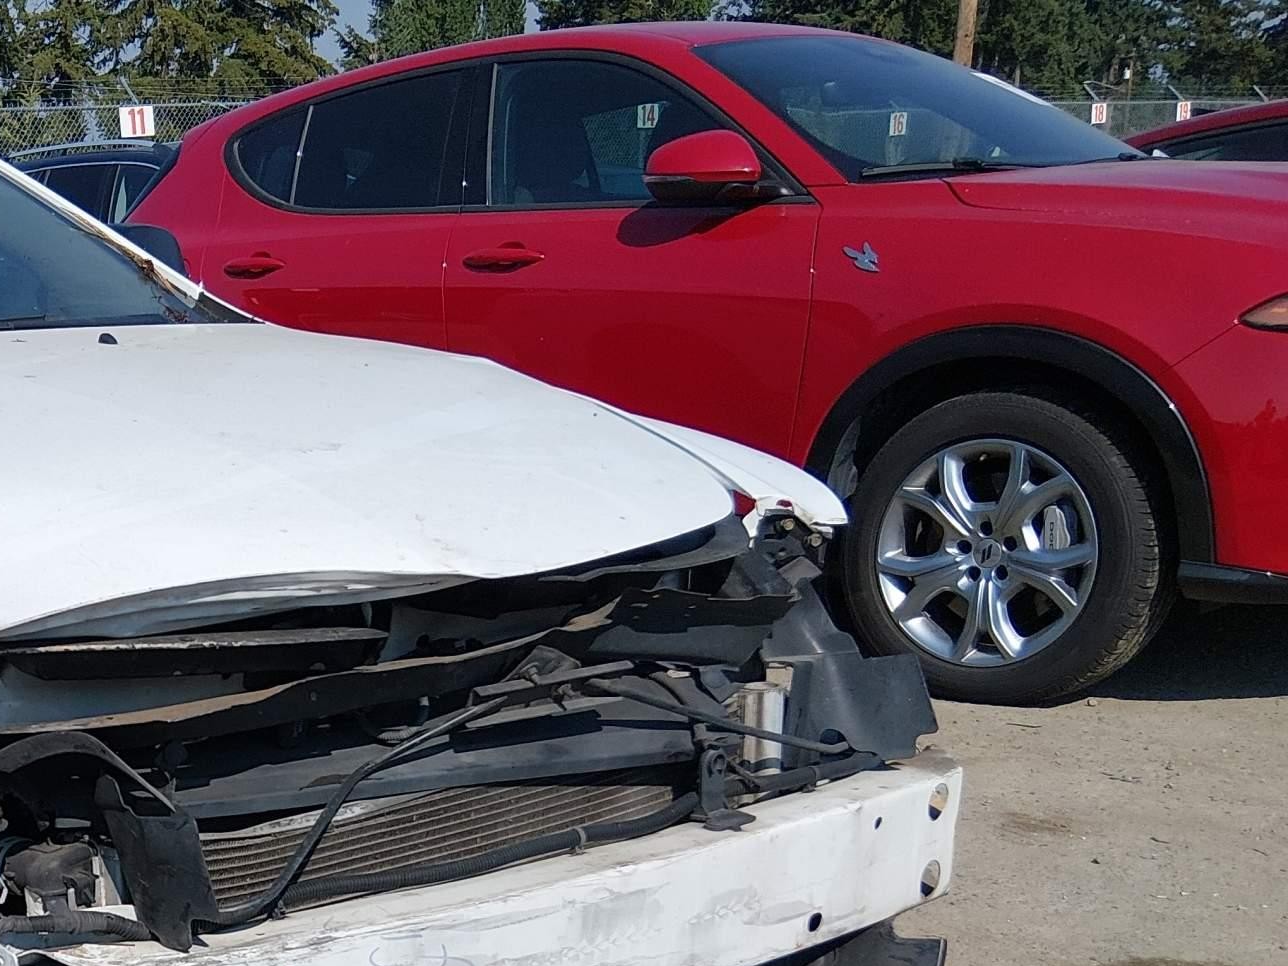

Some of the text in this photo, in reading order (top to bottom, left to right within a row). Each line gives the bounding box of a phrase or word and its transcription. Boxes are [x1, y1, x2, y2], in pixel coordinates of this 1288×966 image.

[128, 107, 146, 135] 11
[641, 104, 656, 127] 14
[1094, 104, 1104, 122] 18
[1179, 102, 1189, 120] 19
[893, 113, 905, 134] 16
